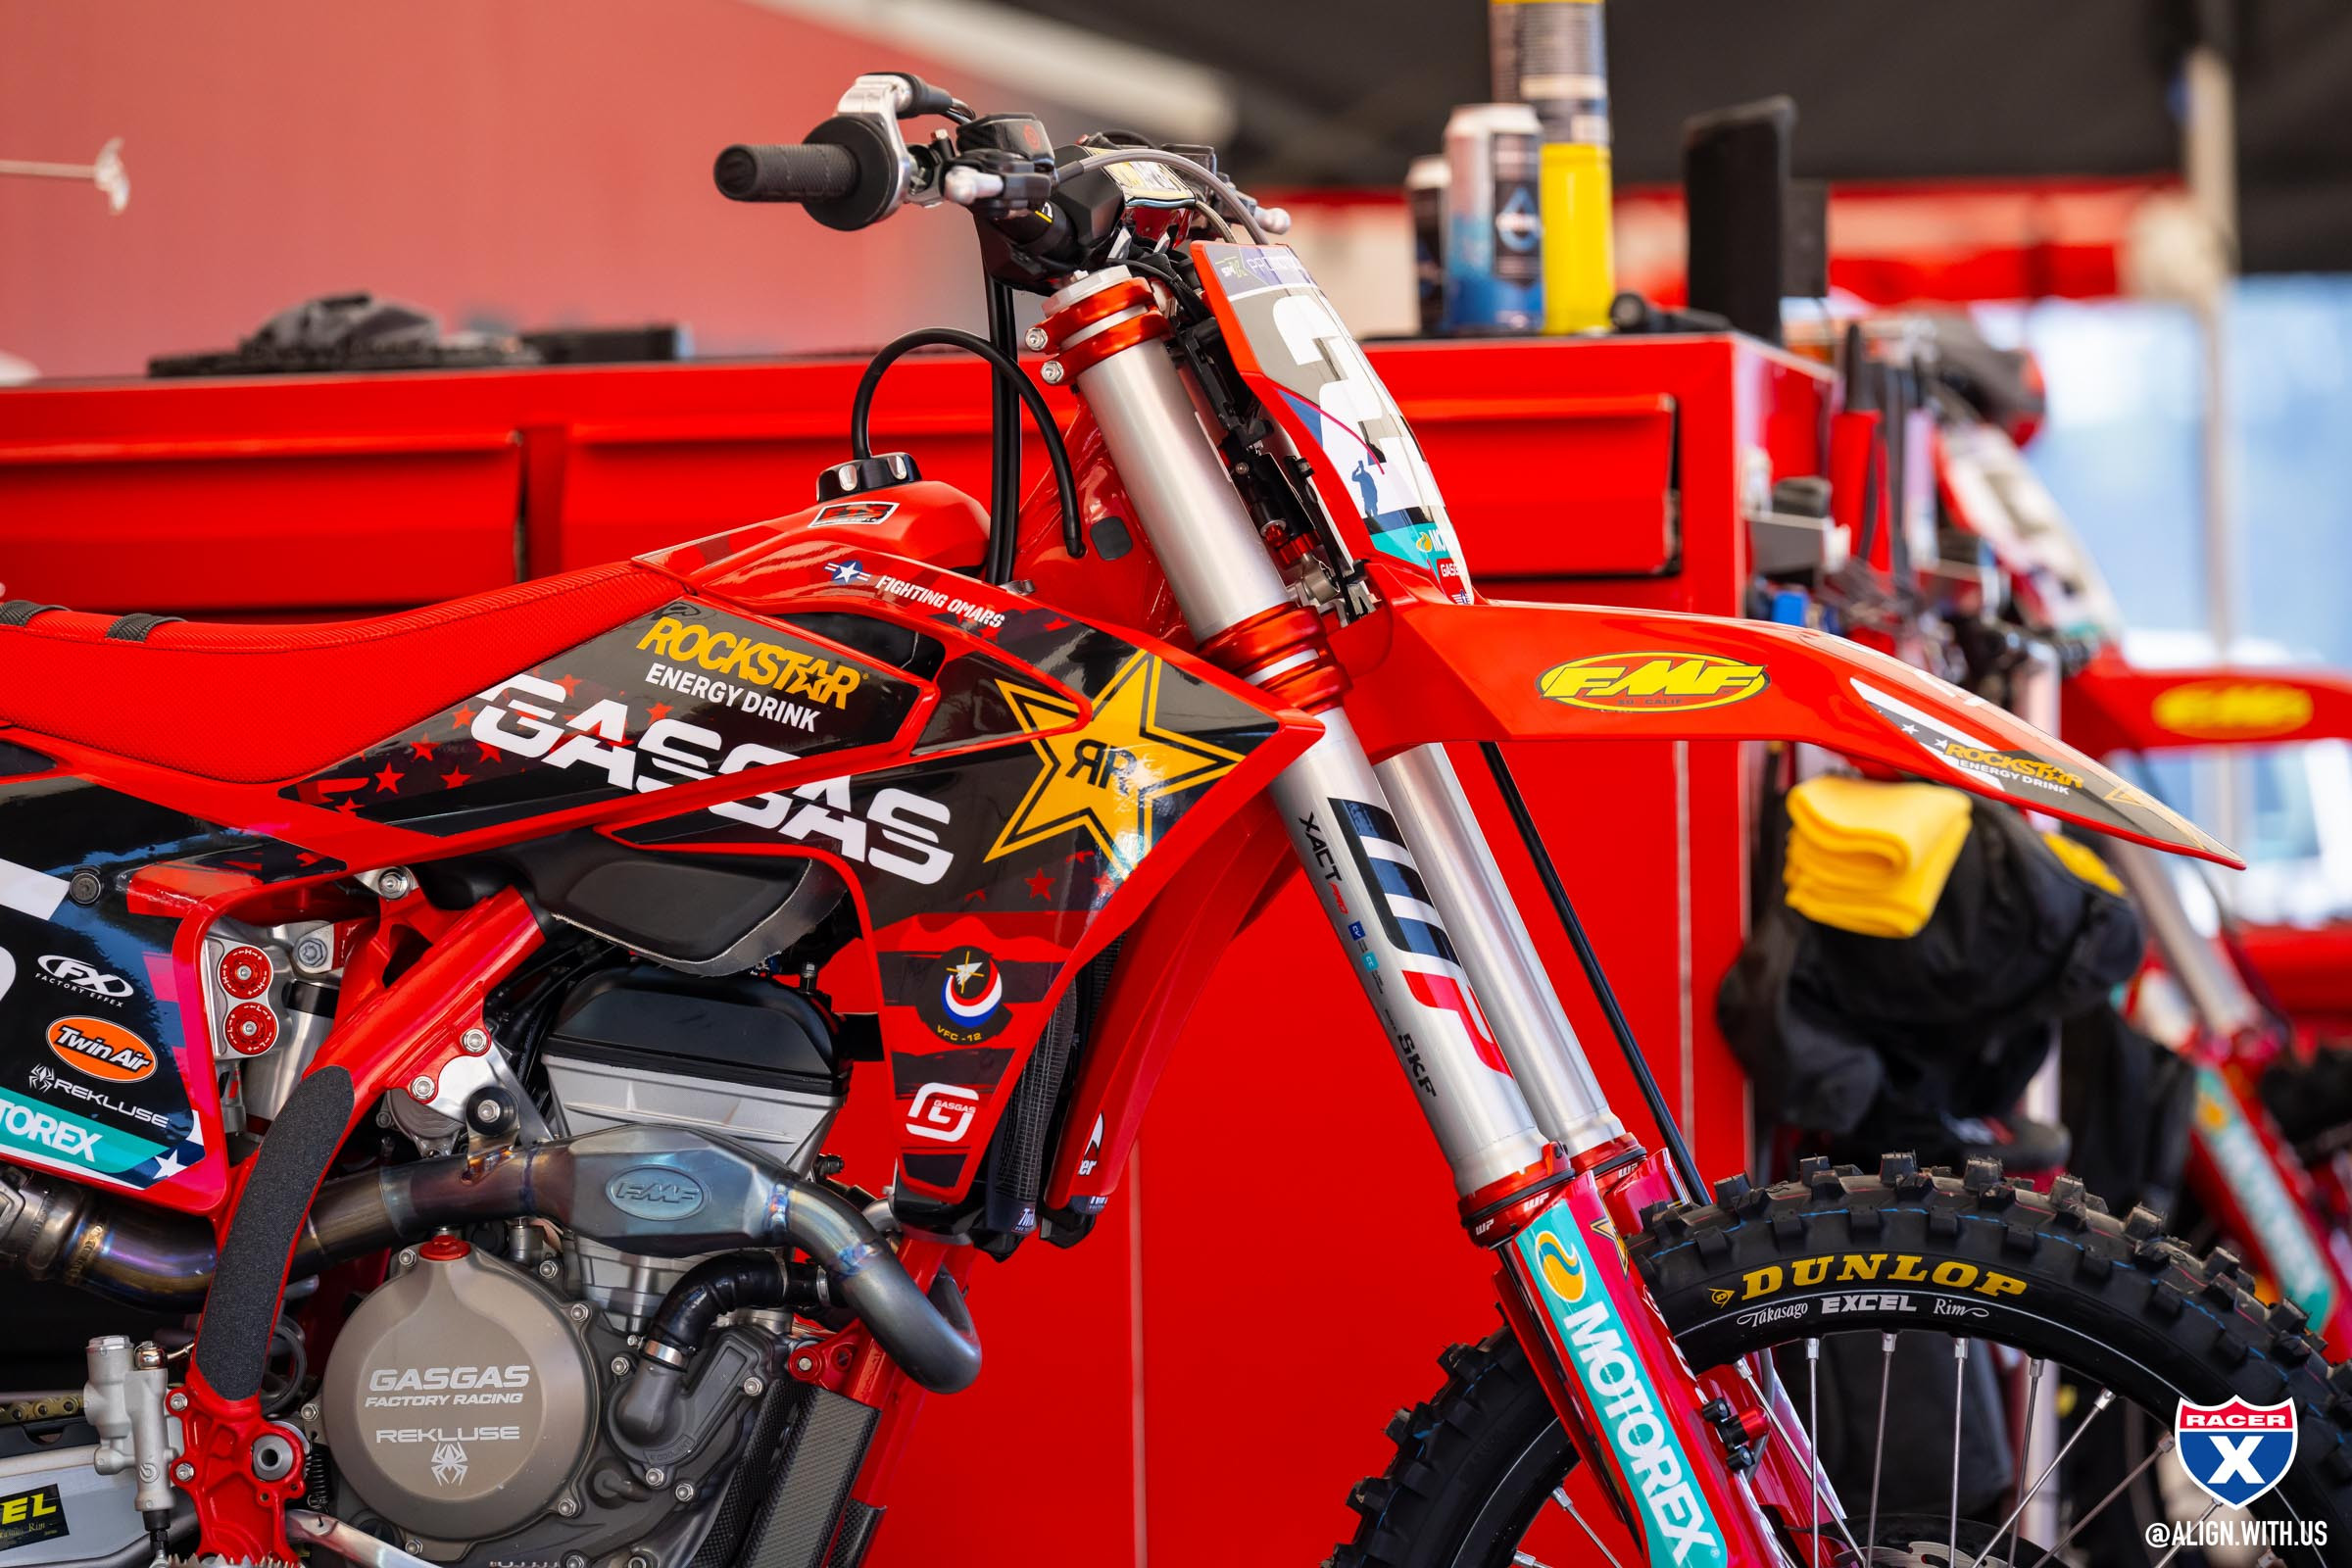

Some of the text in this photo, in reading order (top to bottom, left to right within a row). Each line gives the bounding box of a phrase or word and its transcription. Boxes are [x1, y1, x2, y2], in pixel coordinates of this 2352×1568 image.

[874, 574, 1005, 628] FIGHTING OMARS
[637, 615, 861, 710] ROCKSTAR
[1543, 660, 1765, 698] FMF
[645, 662, 821, 733] ENERGY DRINK
[470, 673, 955, 885] GASGAS
[1944, 743, 2084, 789] ROCKSTAR
[1960, 760, 2070, 795] ENERGY DRINK
[1298, 811, 1342, 882] XACT
[34, 972, 124, 1008] FACTORY EFFEX
[56, 1025, 151, 1072] Twin Air
[936, 1024, 959, 1041] VFC
[1397, 1034, 1438, 1098] SKF
[53, 1079, 170, 1128] REKLUSE
[933, 1100, 977, 1114] GASGAS
[0, 1099, 103, 1162] TOREX
[614, 1181, 701, 1205] FMF
[1523, 1192, 1549, 1212] WP
[1475, 1218, 1494, 1236] WP
[1740, 1253, 2029, 1301] DUNLOP
[1737, 1295, 1989, 1329] Takasago EXCEL Rim
[368, 1365, 531, 1392] GASGAS
[365, 1393, 523, 1407] FACTORY RACING
[375, 1426, 520, 1444] REKLUSE
[1563, 1300, 1718, 1566] MOTOREX
[0, 1493, 57, 1525] EL
